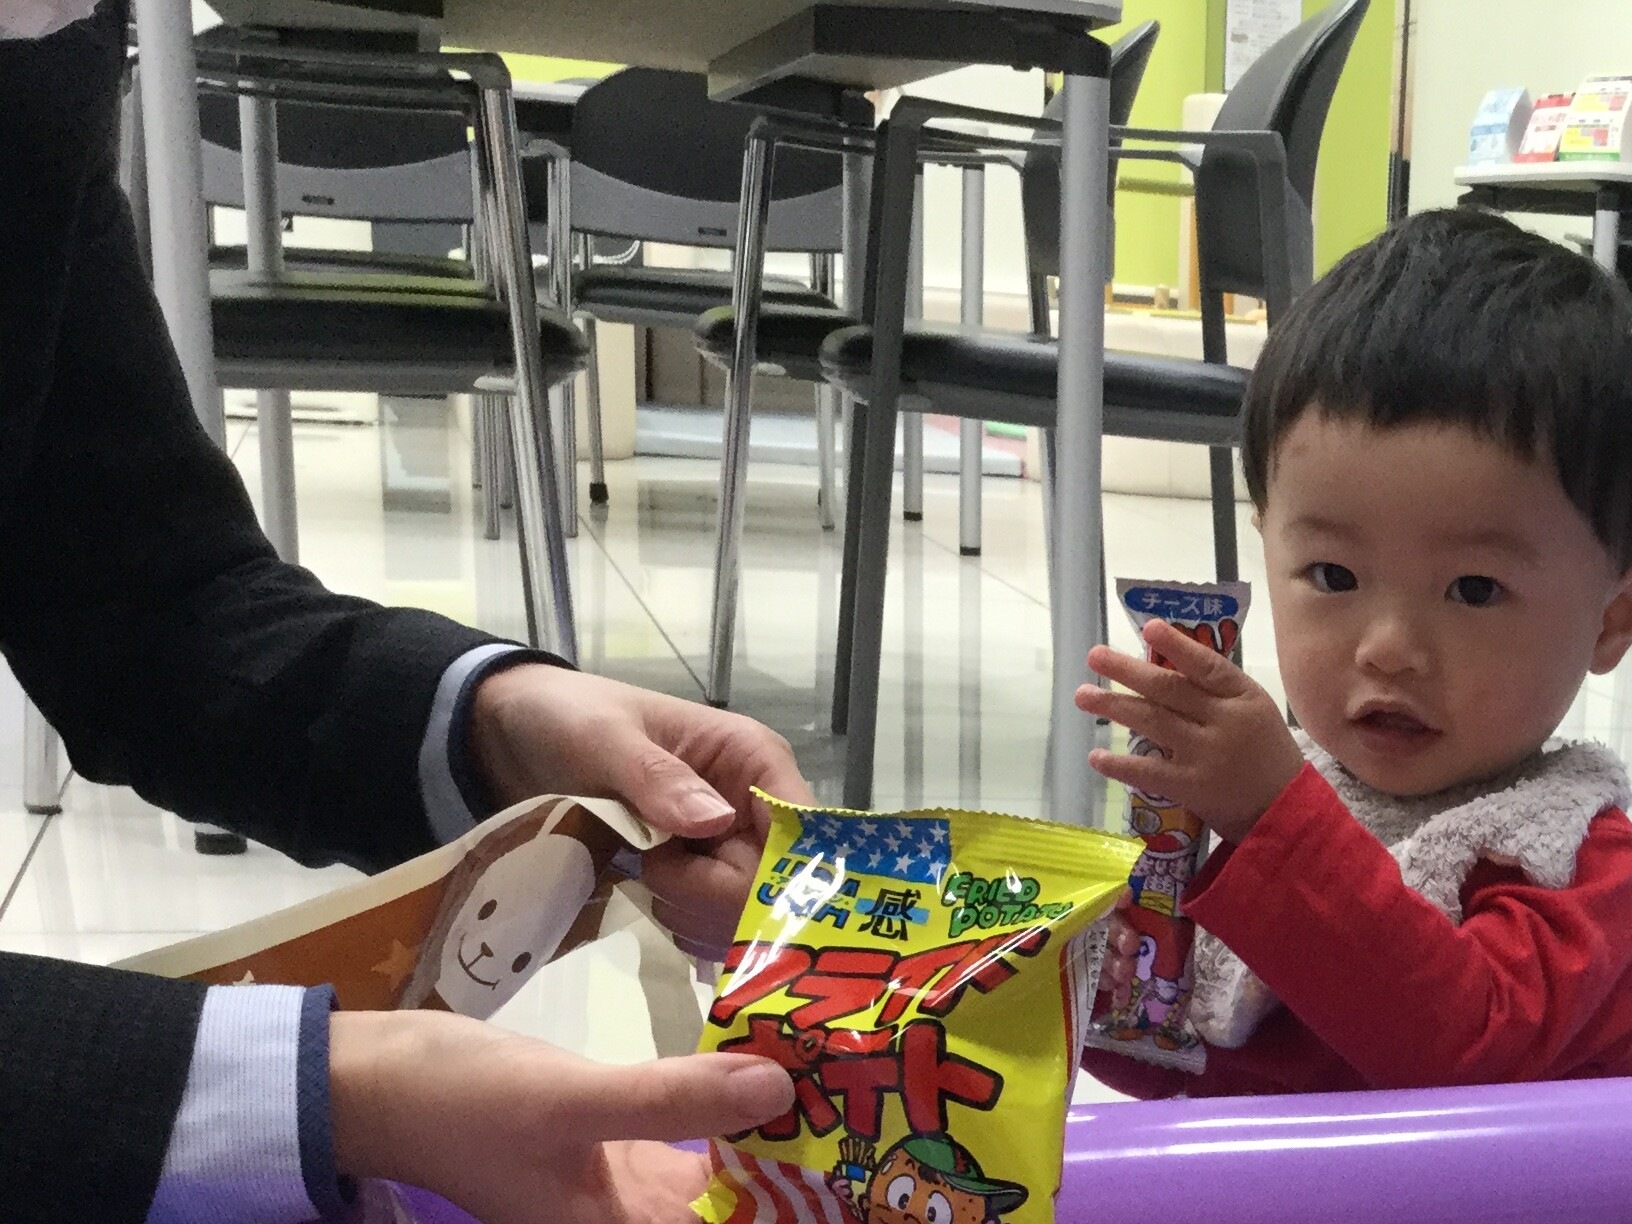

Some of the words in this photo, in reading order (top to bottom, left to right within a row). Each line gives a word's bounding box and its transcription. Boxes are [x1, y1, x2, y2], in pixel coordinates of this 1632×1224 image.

[1141, 593, 1224, 617] チーズ味
[941, 871, 1041, 906] FRIED
[859, 888, 921, 940] 感
